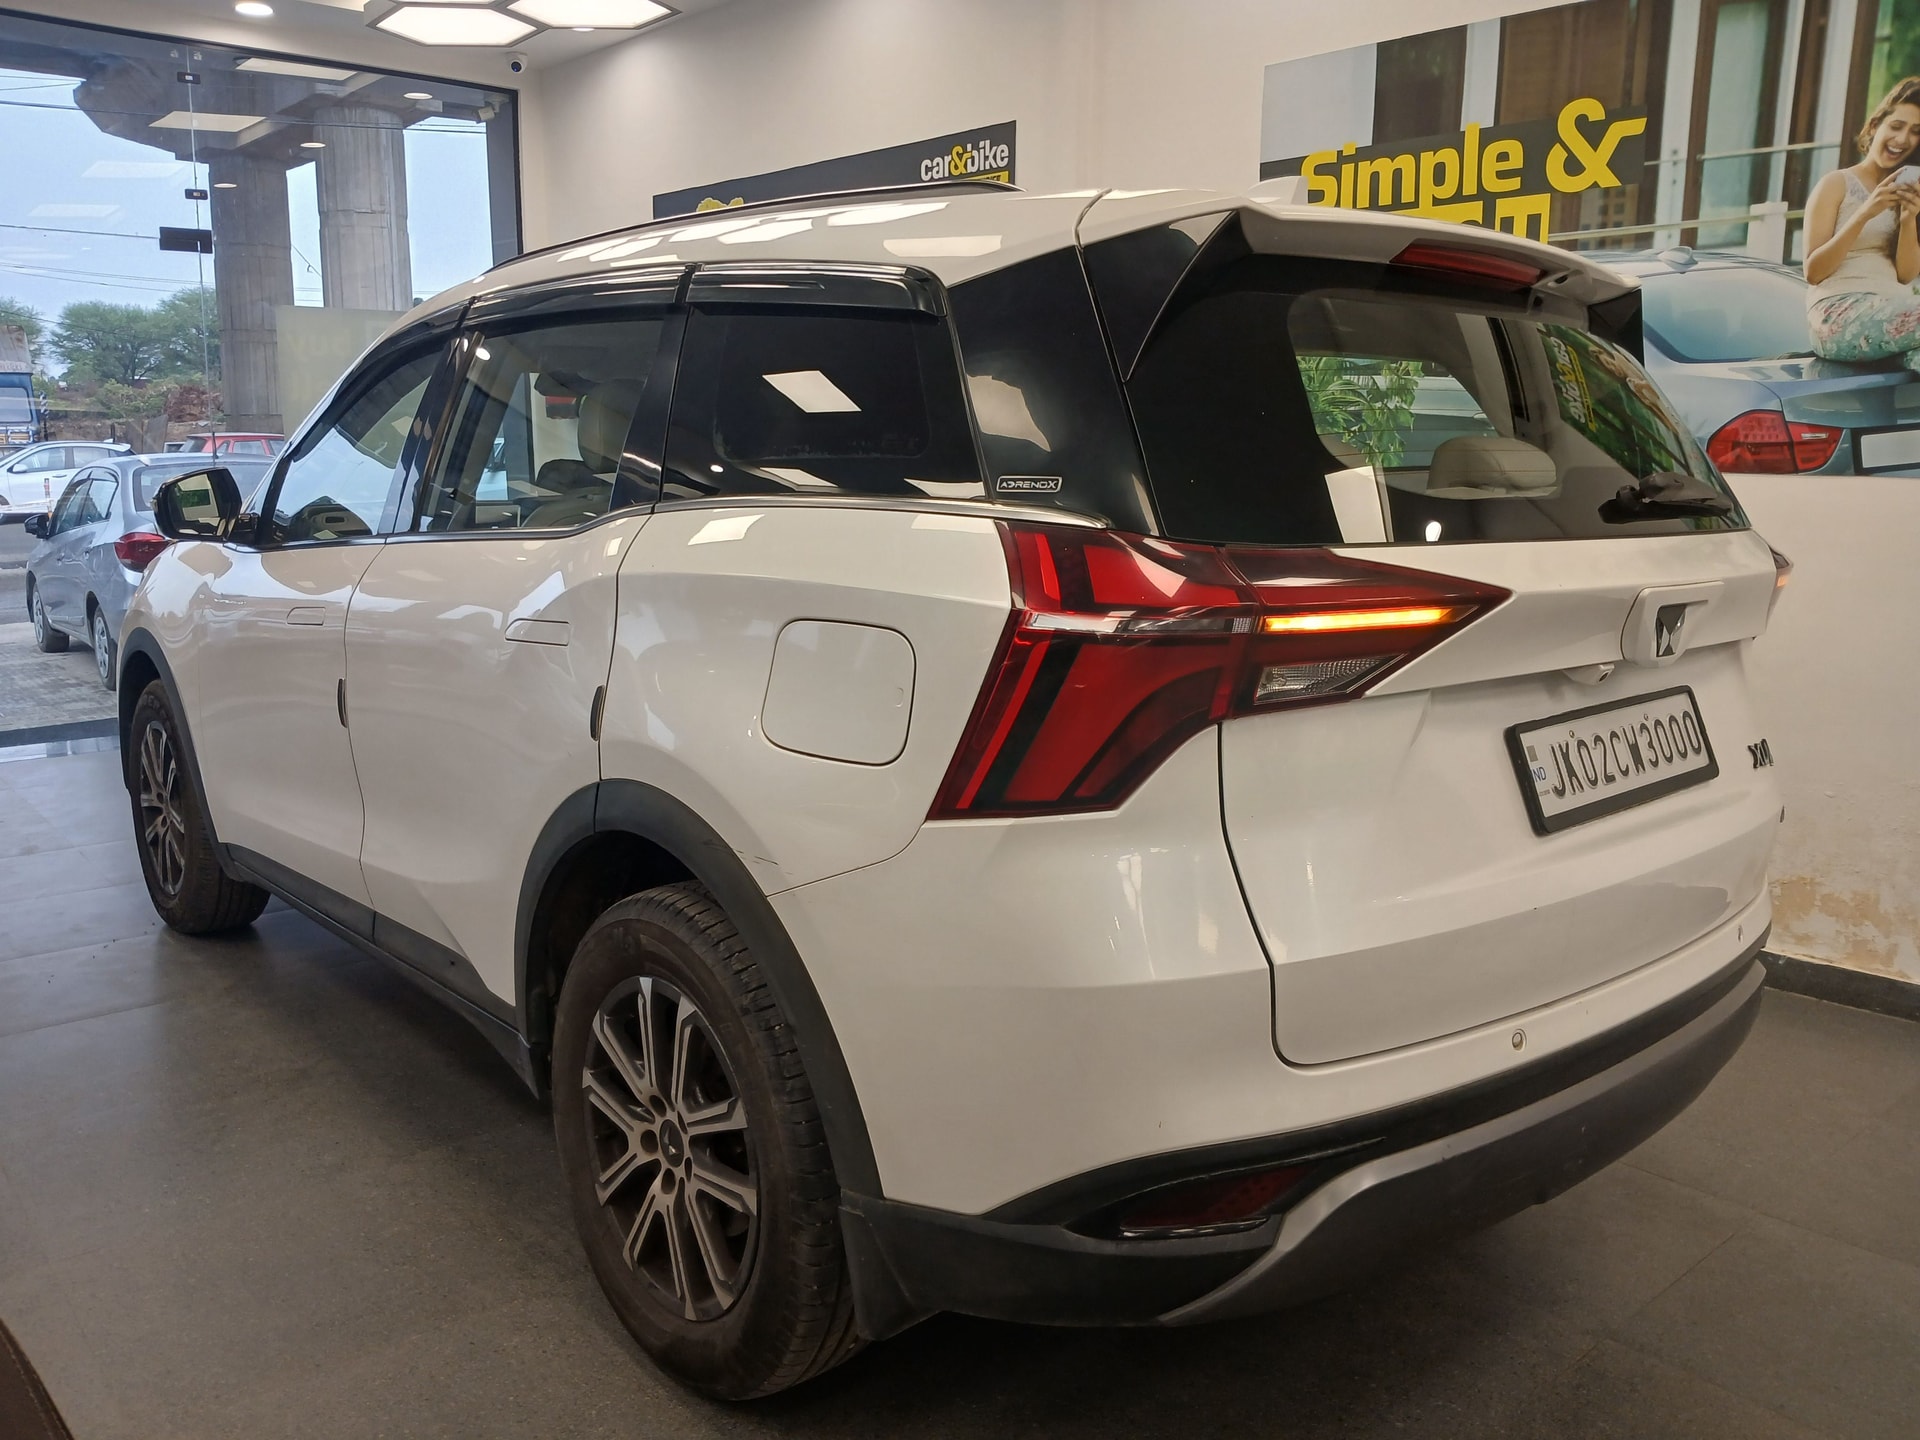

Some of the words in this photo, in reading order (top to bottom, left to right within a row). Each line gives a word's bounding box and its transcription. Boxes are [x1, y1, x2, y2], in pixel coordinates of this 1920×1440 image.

[920, 139, 1009, 181] car&bike
[1301, 122, 1524, 212] Simple
[1546, 97, 1647, 193] &
[1000, 480, 1058, 490] ADRENOX
[1550, 711, 1702, 798] JK02CW3000
